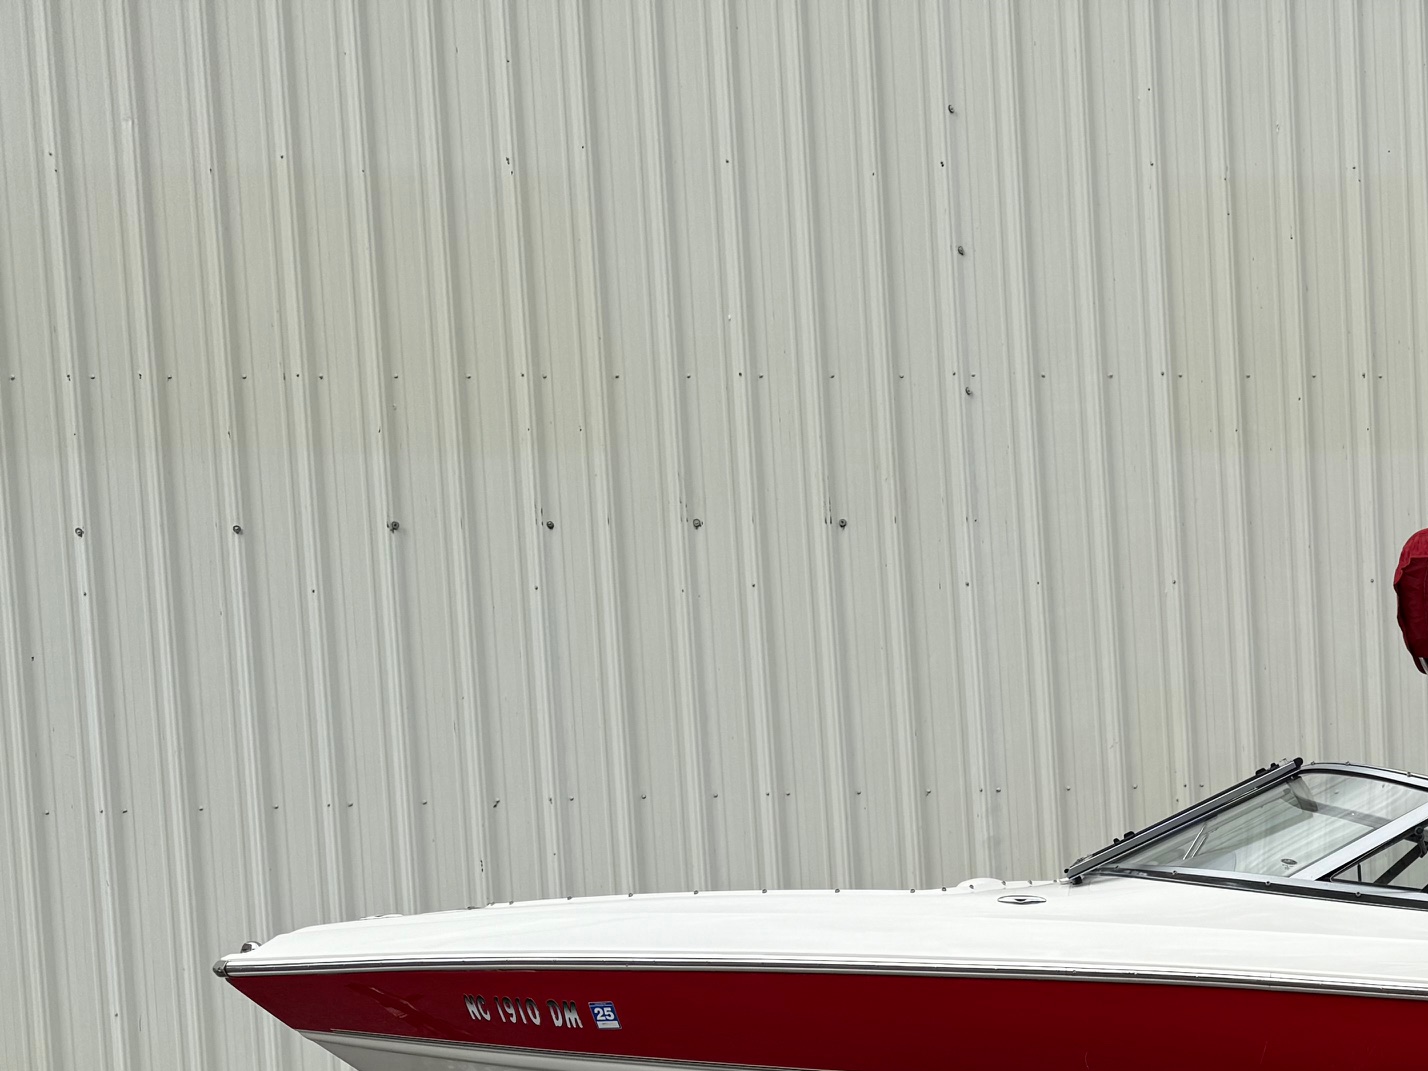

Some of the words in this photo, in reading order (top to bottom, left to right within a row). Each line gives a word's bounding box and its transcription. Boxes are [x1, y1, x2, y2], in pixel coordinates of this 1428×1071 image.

[464, 993, 491, 1021] NC
[494, 995, 540, 1026] 1910
[547, 999, 583, 1028] DM
[594, 1007, 615, 1021] 25
